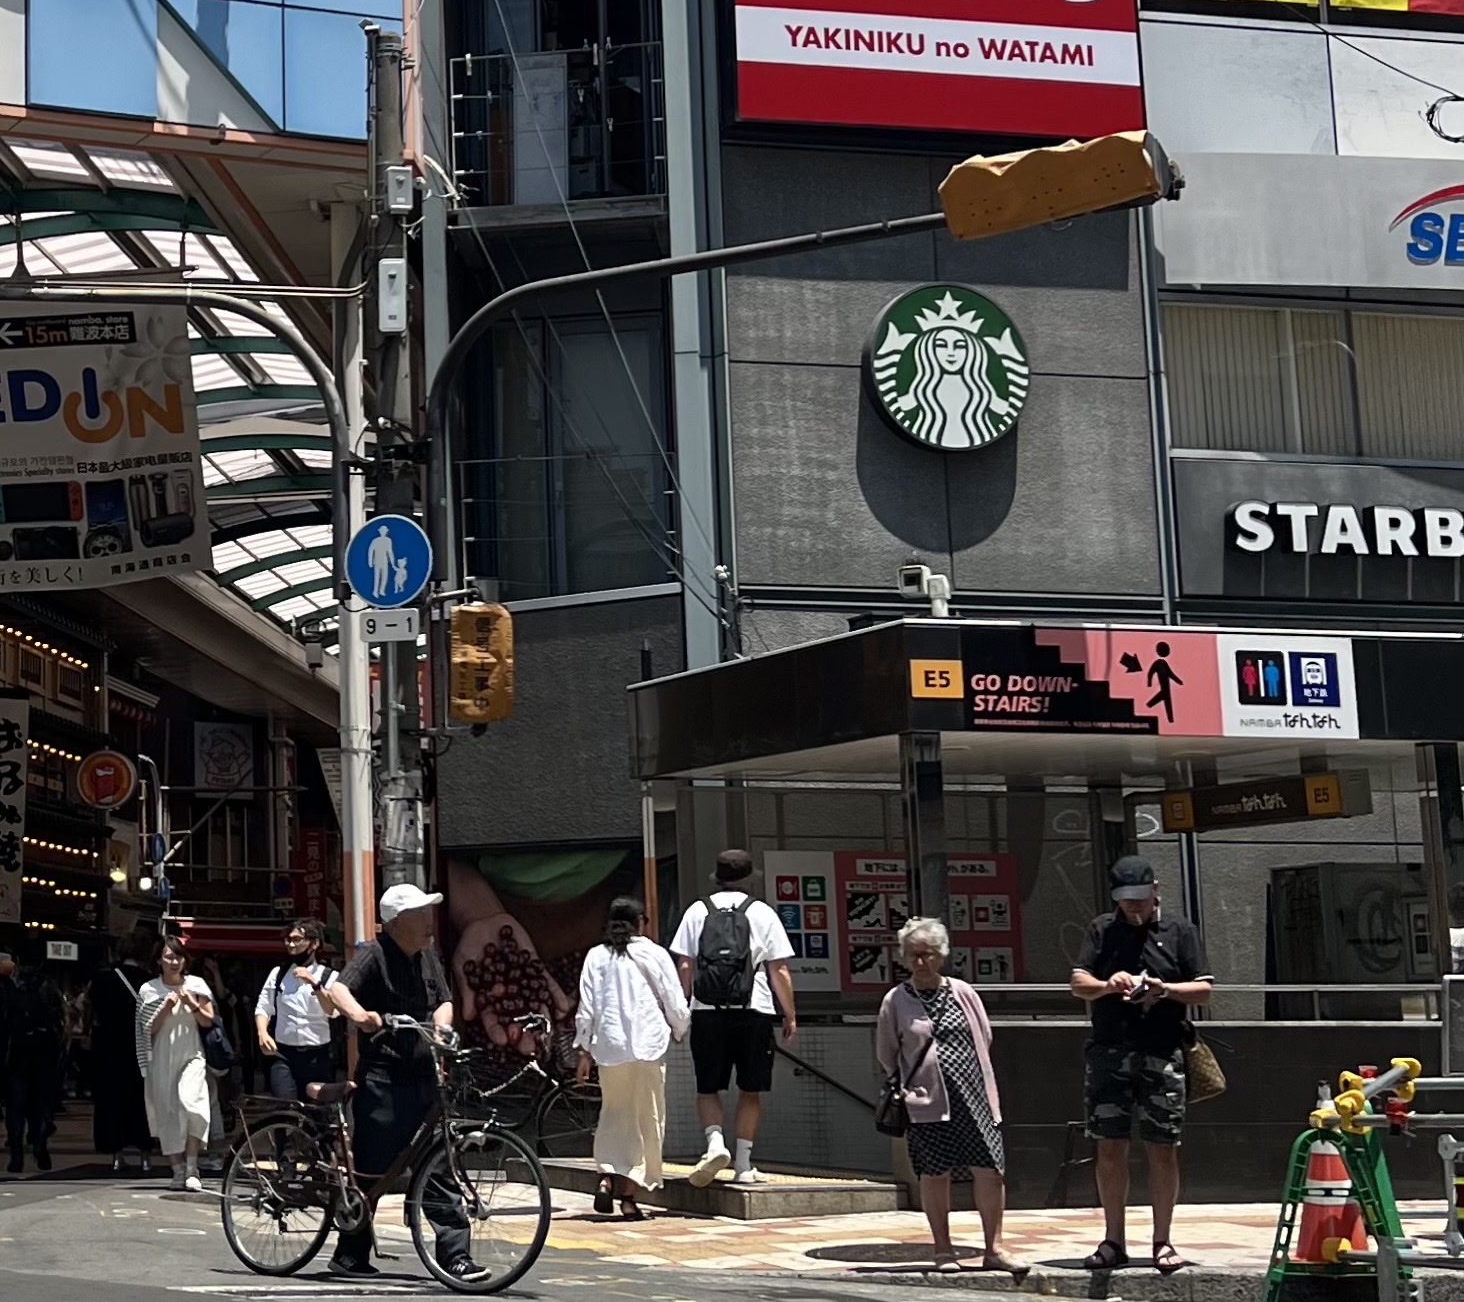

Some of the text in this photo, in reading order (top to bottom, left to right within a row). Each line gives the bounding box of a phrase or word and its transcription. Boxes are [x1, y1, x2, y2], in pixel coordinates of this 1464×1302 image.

[784, 23, 1095, 67] YAKINIKU no WATAMI
[25, 324, 130, 345] 15m 難波本店
[924, 670, 951, 689] E5
[970, 673, 1080, 693] GO DOWN-
[1303, 687, 1329, 698] 地下鉄
[973, 694, 1051, 714] STAIRS!
[1240, 718, 1283, 729] NAMBA
[1313, 787, 1330, 803] E5
